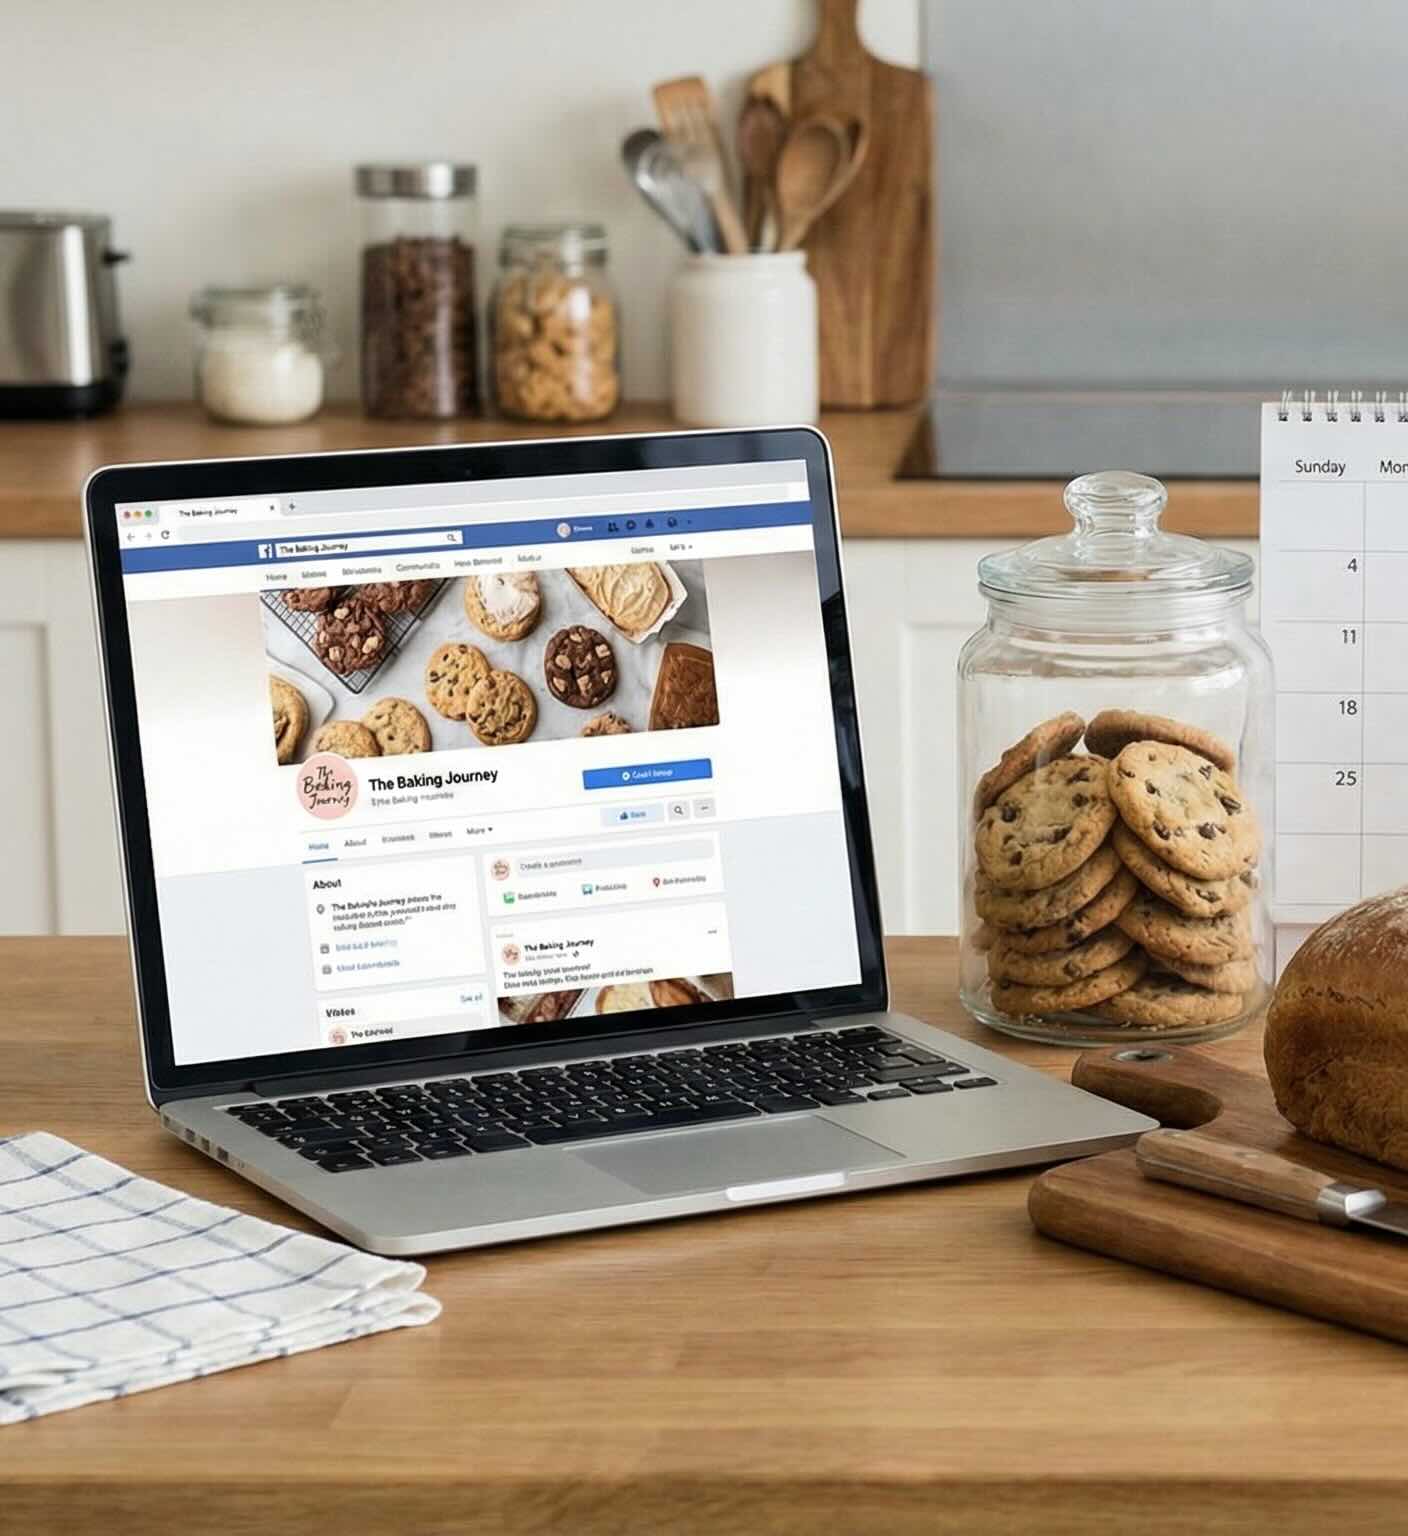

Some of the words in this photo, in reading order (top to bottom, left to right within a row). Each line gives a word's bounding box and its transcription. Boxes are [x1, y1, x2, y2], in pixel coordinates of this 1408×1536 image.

[1295, 458, 1347, 478] Sunday
[280, 546, 293, 554] The
[1347, 557, 1358, 573] 4
[1341, 628, 1356, 645] 11
[1338, 699, 1358, 716] 18
[368, 779, 394, 792] The
[397, 773, 443, 789] Baking
[445, 769, 498, 785] Journey
[1335, 770, 1357, 787] 25
[309, 793, 350, 809] Journey
[313, 879, 342, 889] About
